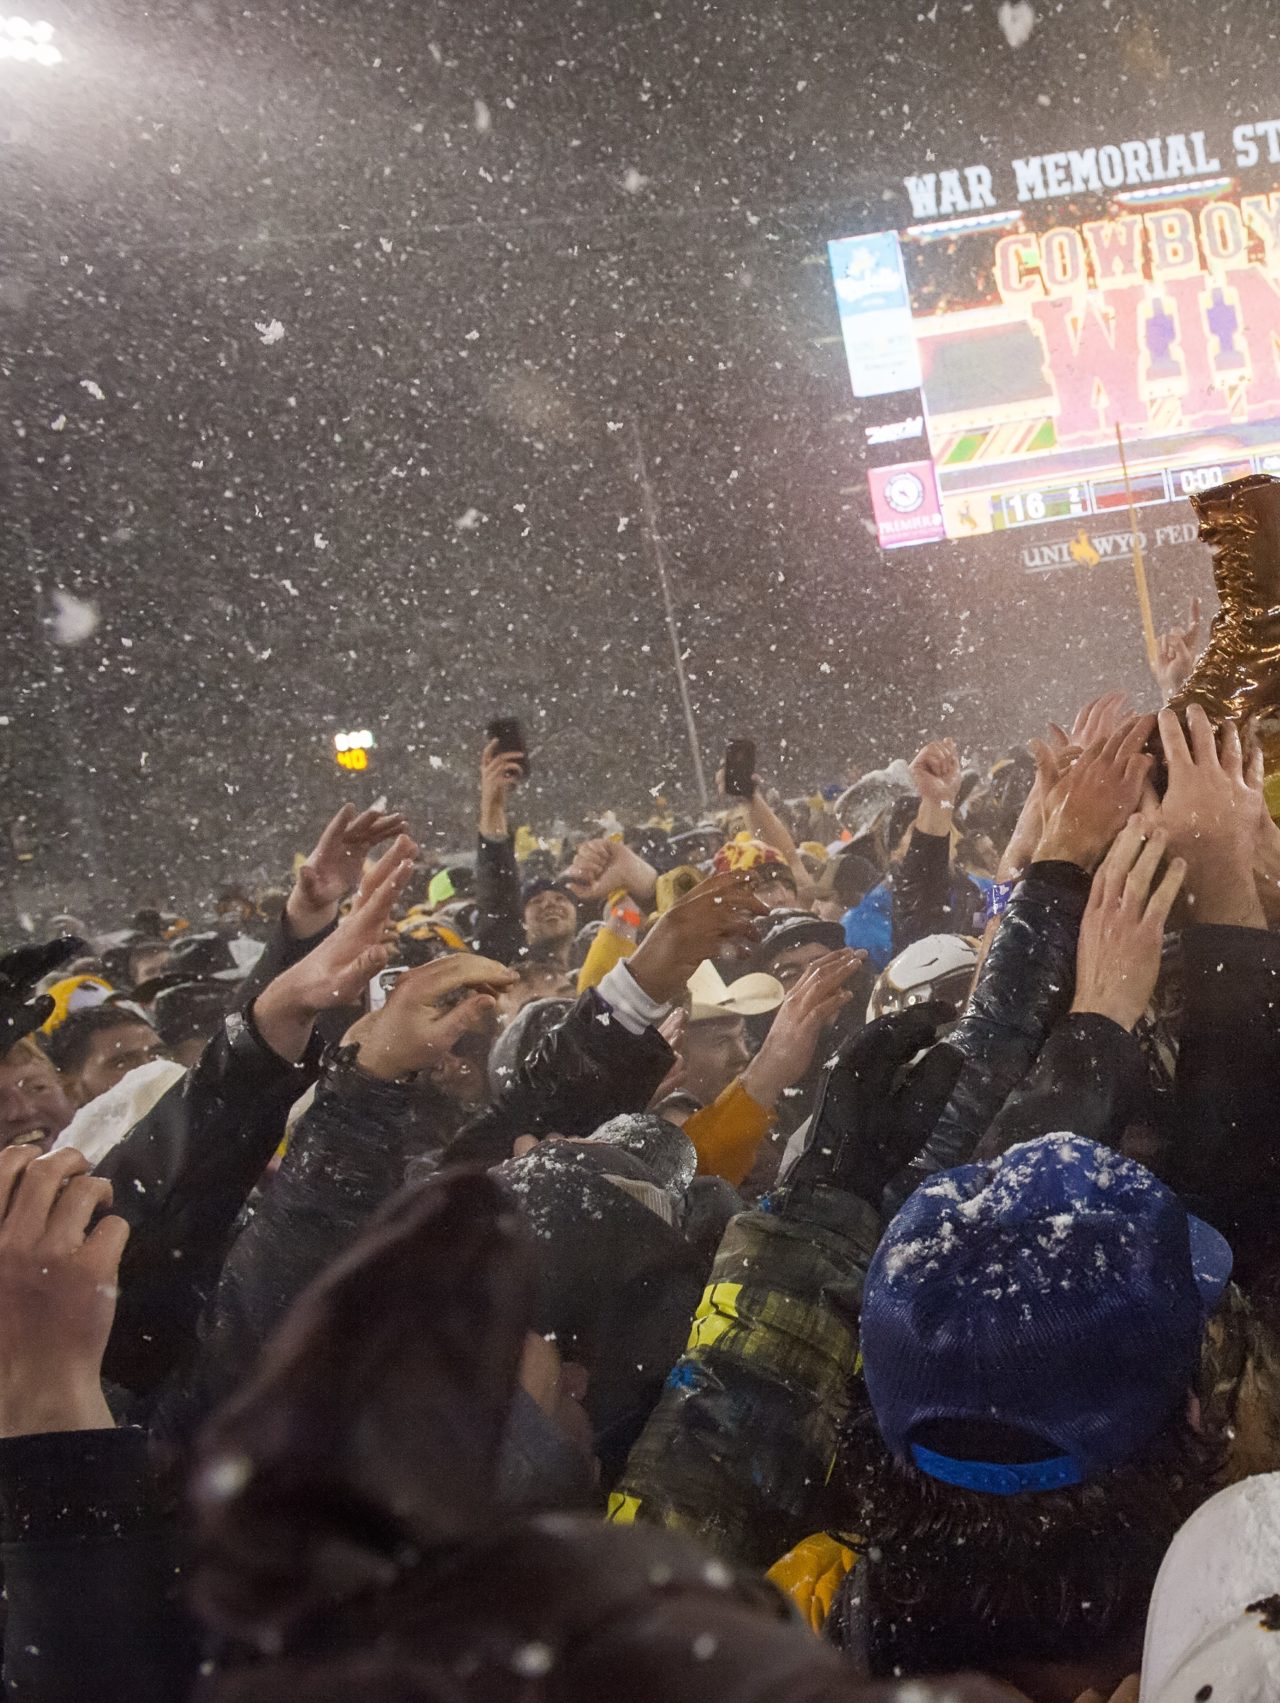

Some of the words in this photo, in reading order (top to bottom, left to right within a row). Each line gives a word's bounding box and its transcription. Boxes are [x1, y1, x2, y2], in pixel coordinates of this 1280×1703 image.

[905, 165, 996, 219] WAR
[1011, 131, 1220, 201] MEMORIAL
[1180, 466, 1223, 493] 0:00
[1009, 491, 1046, 522] 16
[1092, 532, 1147, 556] WYO
